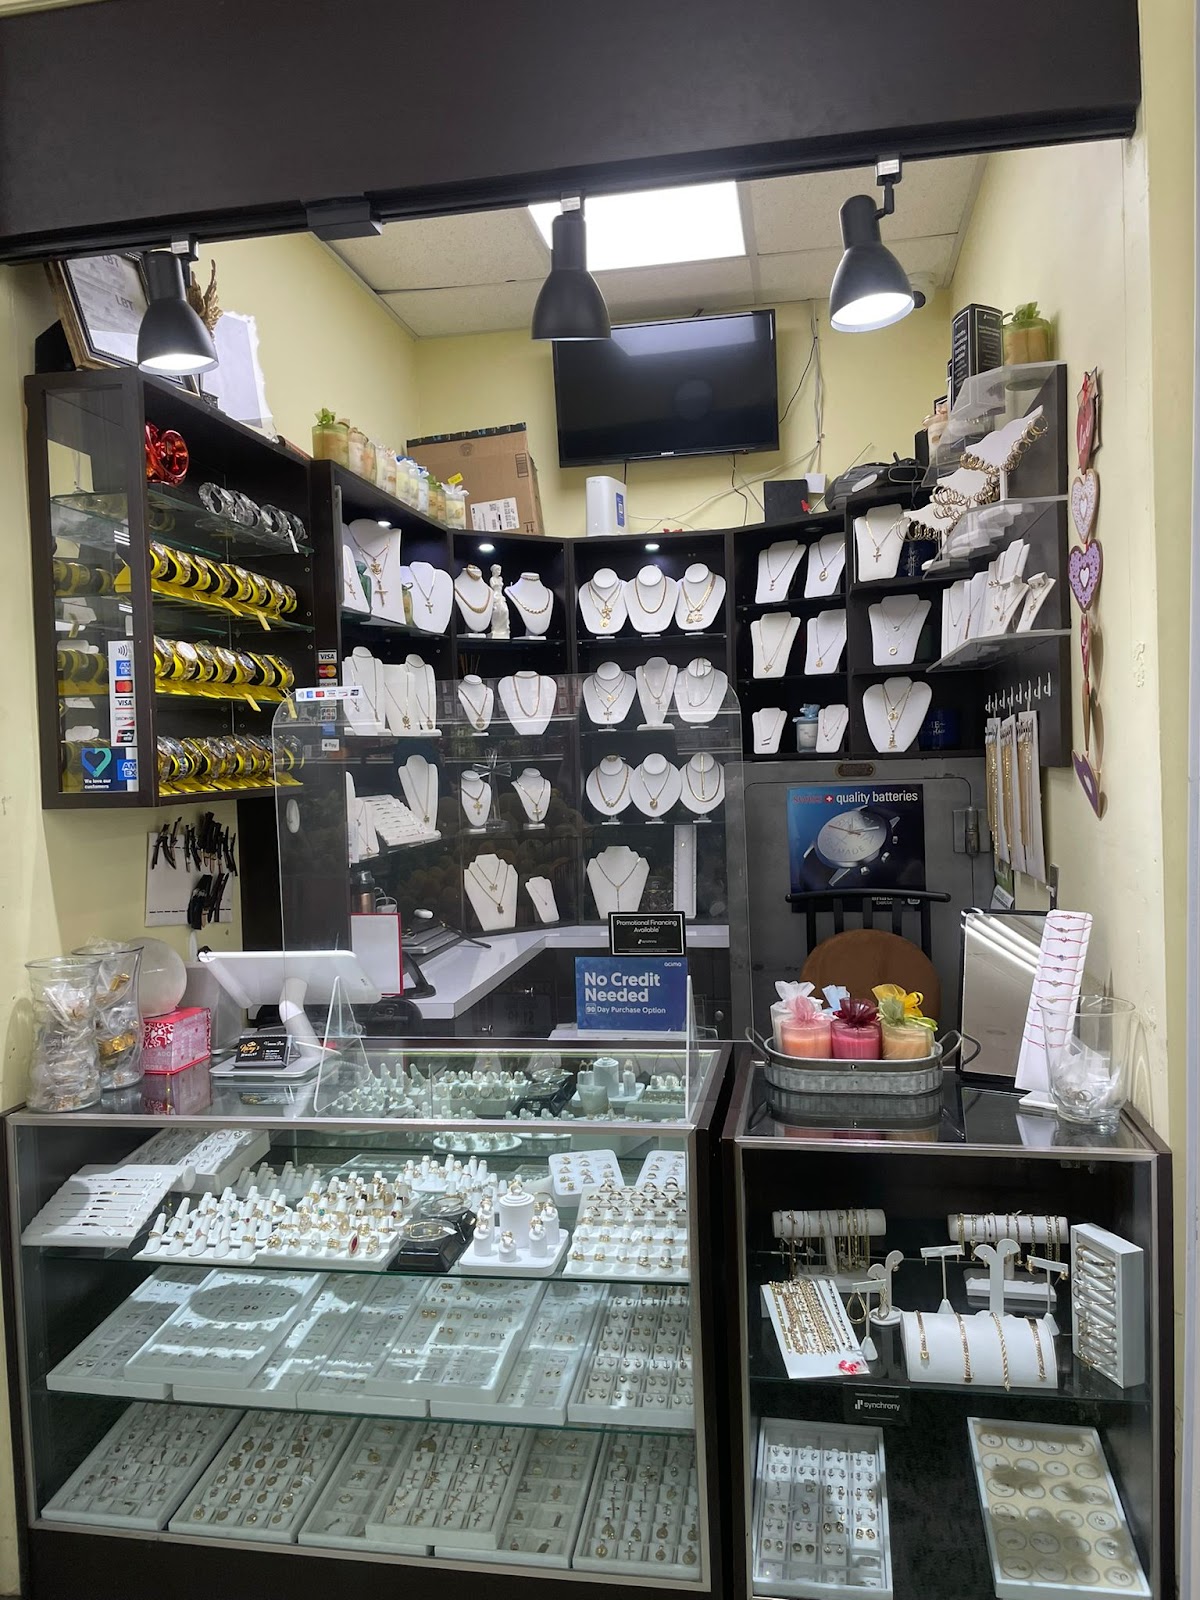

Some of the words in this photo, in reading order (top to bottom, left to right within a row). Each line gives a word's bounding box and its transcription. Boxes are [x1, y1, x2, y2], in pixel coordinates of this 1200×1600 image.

[836, 791, 871, 806] quality
[872, 789, 918, 803] batteries
[584, 971, 608, 987] No
[610, 971, 661, 987] Credit
[584, 987, 649, 1003] Needed
[597, 1006, 610, 1014] Day
[642, 1006, 667, 1014] Option
[864, 1402, 900, 1411] synchrony
